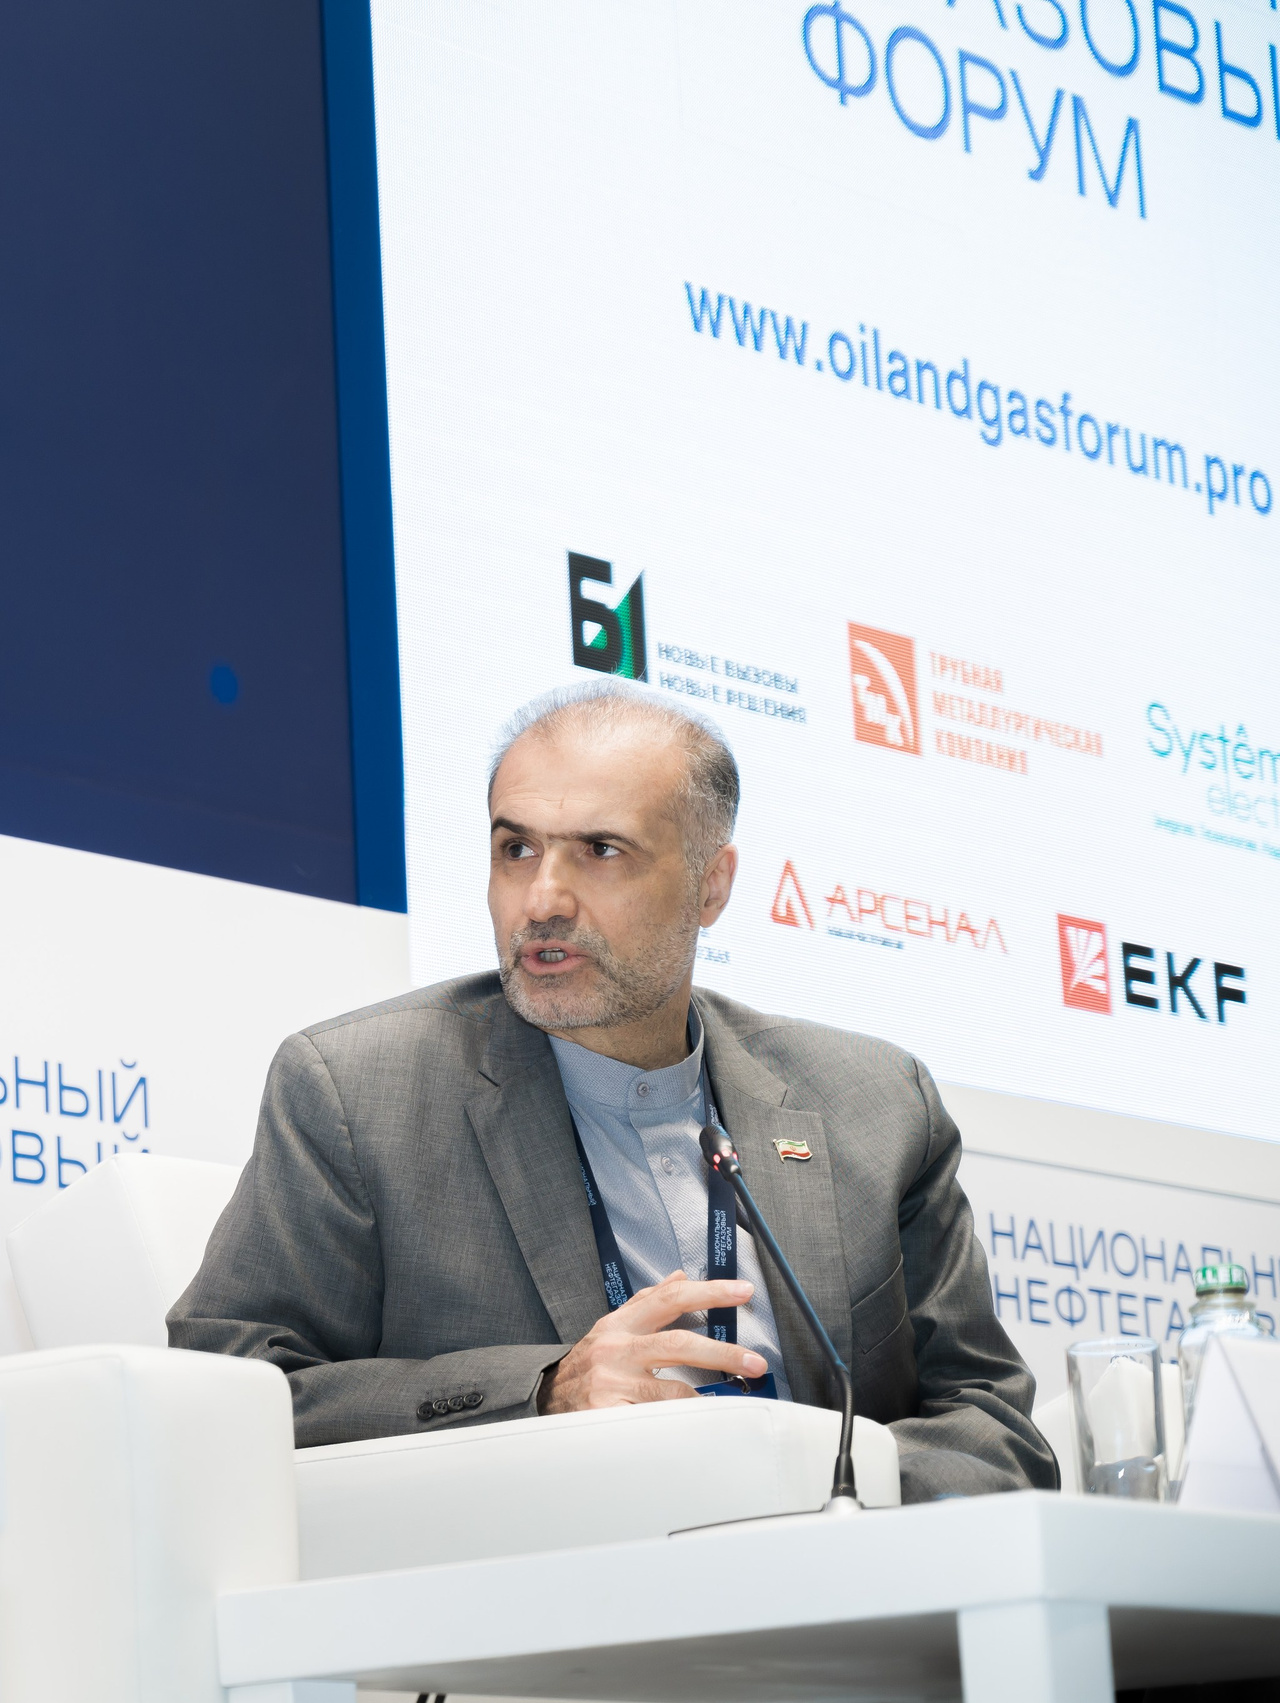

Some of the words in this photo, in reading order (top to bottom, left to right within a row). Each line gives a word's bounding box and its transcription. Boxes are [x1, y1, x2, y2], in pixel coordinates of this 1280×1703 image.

[802, 0, 1148, 220] ФОРУМ
[683, 280, 1274, 516] www.oilandgasforum.pro
[929, 651, 1004, 694] ТРУБНАЯ
[931, 690, 1104, 759] МЕТАЛЛУРГИЧЕСКАЯ
[934, 728, 1029, 776] КОМПАНИЯ
[825, 884, 1009, 955] АРСЕНАЛ
[1122, 941, 1247, 1025] EKF
[605, 1263, 622, 1307] НЕФТЕГАЗО
[989, 1211, 1280, 1300] НАЦИОНАН
[604, 1280, 617, 1306] ФОРУМ
[994, 1273, 1276, 1341] НЕФТЕГА
